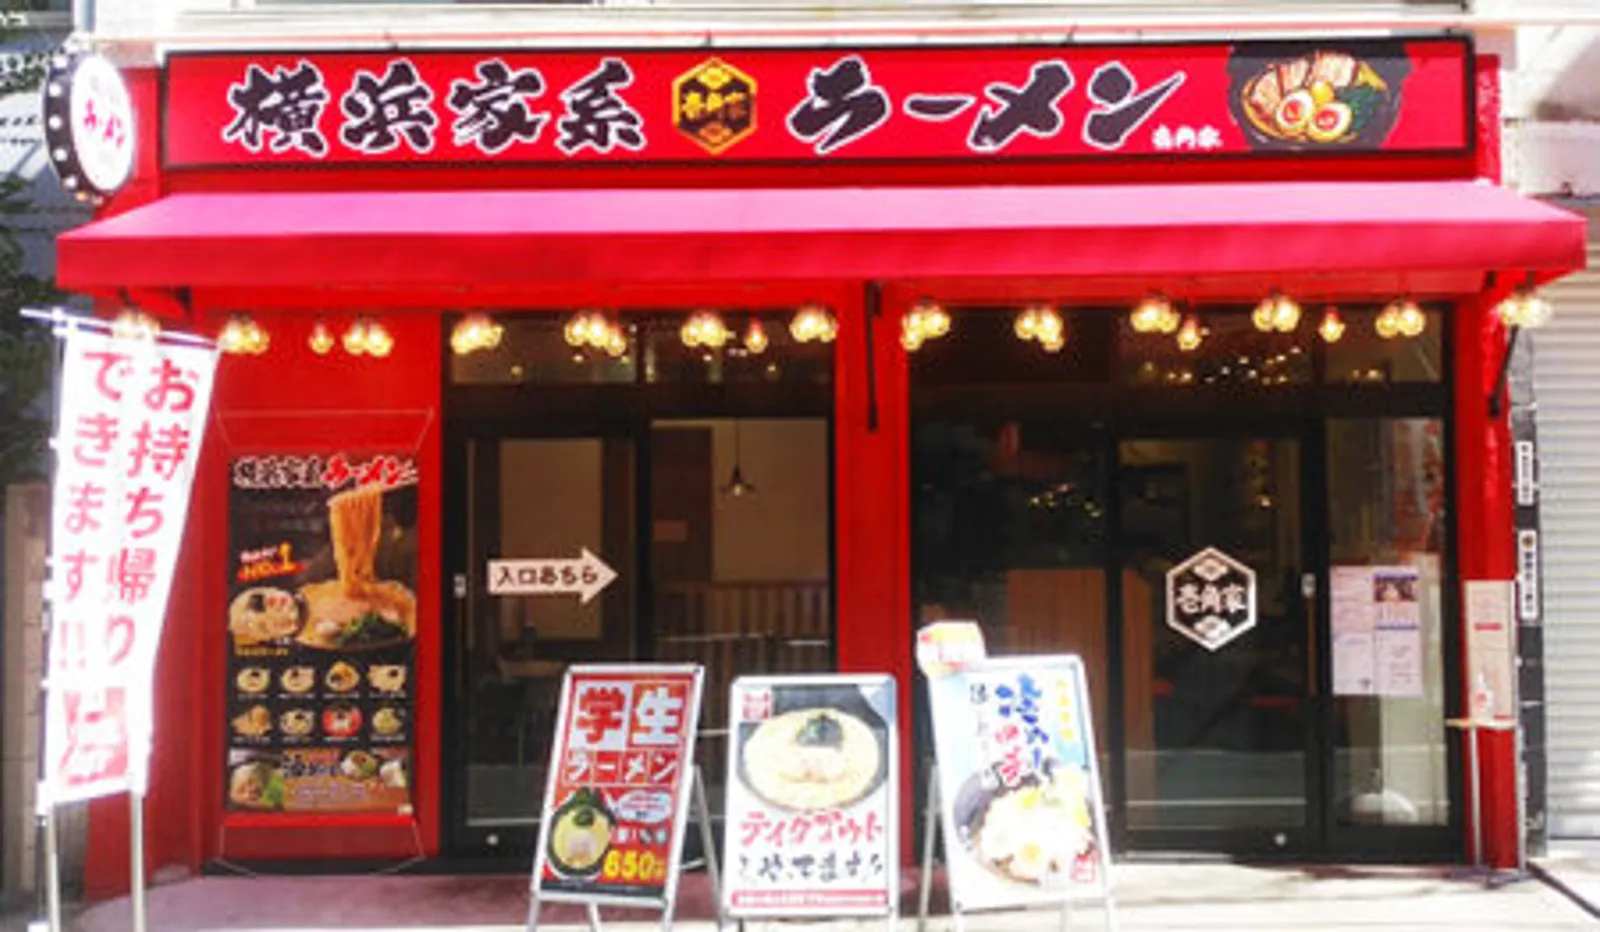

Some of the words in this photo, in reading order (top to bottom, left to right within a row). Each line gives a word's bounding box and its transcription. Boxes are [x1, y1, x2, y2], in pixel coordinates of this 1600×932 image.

[222, 57, 646, 155] 横浜家系
[785, 54, 1187, 155] ラーメン
[104, 357, 201, 667] お持ち帰り
[496, 565, 599, 588] 入口あちら
[1175, 583, 1248, 614] 壱角家
[575, 686, 684, 744] 学生
[567, 752, 678, 782] ラーメン
